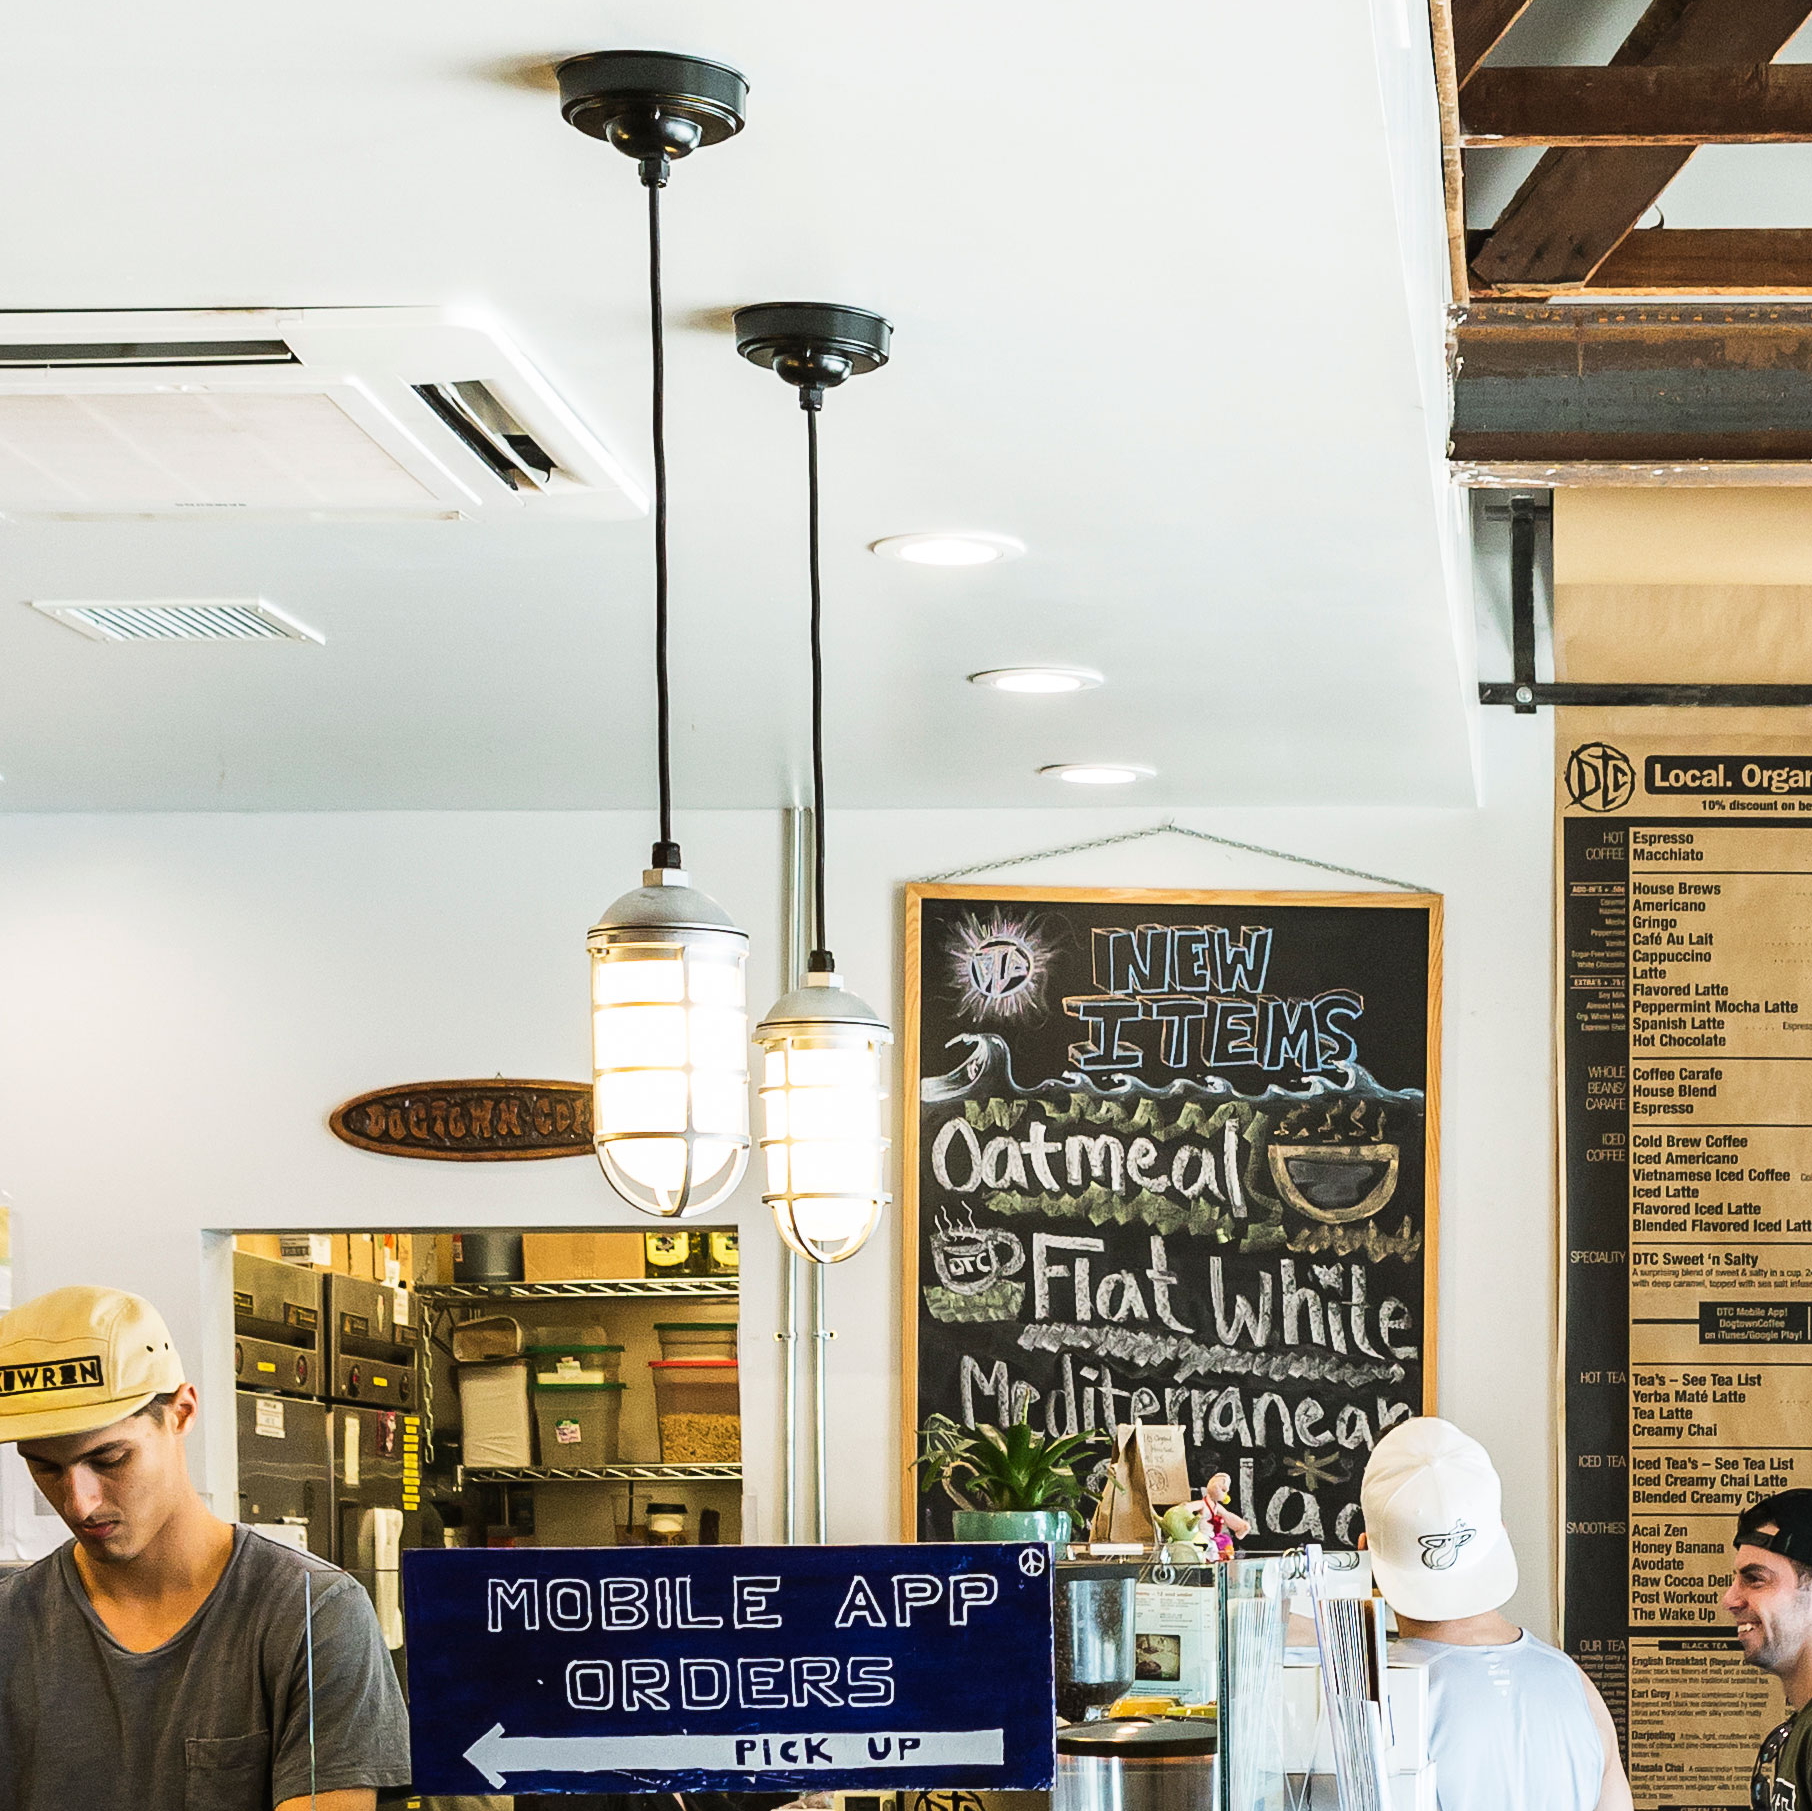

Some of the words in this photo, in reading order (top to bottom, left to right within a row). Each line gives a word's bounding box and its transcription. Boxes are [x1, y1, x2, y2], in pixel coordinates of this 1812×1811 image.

[1654, 763, 1733, 787] Local.
[1701, 799, 1726, 811] 10%
[1729, 799, 1779, 811] discount
[1780, 802, 1795, 811] on
[1603, 831, 1625, 845] HOT
[1632, 831, 1694, 847] Espresso
[1585, 847, 1625, 861] COFFEE
[1632, 847, 1704, 861] Macchiato
[1632, 881, 1675, 895] House
[1678, 881, 1721, 896] Brews
[1632, 898, 1706, 912] Americano
[1632, 915, 1677, 932] Gringo
[1632, 931, 1663, 946] Café
[1666, 932, 1685, 946] Au
[1688, 932, 1714, 946] Lait
[1091, 926, 1273, 994] NEW
[1632, 949, 1712, 966] Cappuccino
[1632, 966, 1667, 980] Latte
[1632, 983, 1691, 997] Flavored
[1694, 983, 1729, 997] Latte
[1632, 999, 1711, 1017] Peppermint
[1715, 999, 1761, 1014] Mocha
[1764, 1000, 1799, 1014] Latte
[1062, 989, 1364, 1071] ITEMS
[1632, 1016, 1687, 1033] Spanish
[1691, 1016, 1725, 1030] Latte
[1632, 1033, 1656, 1047] Hot
[1659, 1033, 1727, 1047] Chocolate
[1632, 1067, 1675, 1081] Coffee
[1679, 1067, 1723, 1081] Carafe
[1632, 1134, 1663, 1148] Cold
[1666, 1134, 1702, 1148] Brew
[1705, 1134, 1749, 1149] Coffee
[1632, 1151, 1662, 1165] Iced
[1665, 1151, 1739, 1165] Americano
[931, 1116, 1248, 1218] Oatmeal
[1632, 1168, 1712, 1182] Vietnamese
[1715, 1168, 1745, 1182] Iced
[1747, 1168, 1791, 1182] Coffee
[1632, 1201, 1691, 1215] Flavored
[1694, 1201, 1724, 1216] Iced
[1727, 1202, 1762, 1216] Latte
[1632, 1218, 1687, 1232] Blended
[1691, 1218, 1750, 1233] Flavored
[1753, 1219, 1782, 1233] Iced
[949, 1252, 992, 1276] DTC
[1569, 1251, 1626, 1265] SPECIALITY
[1632, 1252, 1659, 1266] DTC
[1662, 1252, 1705, 1266] Sweet
[1707, 1253, 1721, 1266] 'n
[1723, 1252, 1759, 1269] Salty
[1033, 1232, 1195, 1335] Flat
[1209, 1254, 1418, 1360] White
[1631, 1373, 1666, 1387] Tea's
[1681, 1373, 1707, 1387] See
[1710, 1373, 1733, 1387] Tea
[1737, 1372, 1763, 1387] List
[1632, 1389, 1671, 1404] Yerba
[1674, 1389, 1709, 1403] Maté
[1712, 1389, 1746, 1404] Latte
[1632, 1423, 1684, 1440] Creamy
[1687, 1423, 1718, 1437] Chai
[1632, 1456, 1661, 1471] Iced
[1664, 1456, 1699, 1471] Tea's
[1714, 1457, 1739, 1471] See
[1742, 1457, 1766, 1471] Tea
[1769, 1457, 1795, 1471] List
[1632, 1473, 1661, 1487] Iced
[1664, 1473, 1717, 1490] Creamy
[1720, 1473, 1750, 1487] Chai
[1753, 1473, 1788, 1488] Latte
[1632, 1490, 1687, 1504] Blended
[1690, 1490, 1743, 1507] Creamy
[1565, 1521, 1626, 1535] SMOOTHIES
[1631, 1523, 1661, 1537] Acai
[1663, 1523, 1688, 1537] Zen
[1631, 1540, 1673, 1557] Honey
[1675, 1540, 1725, 1555] Banana
[1631, 1557, 1685, 1571] Avodate
[1631, 1573, 1661, 1588] Raw
[1664, 1573, 1705, 1588] Cocoa
[488, 1575, 783, 1632] MOBILE
[835, 1574, 999, 1629] APP
[1631, 1590, 1660, 1604] Post
[1663, 1590, 1719, 1605] Workout
[1631, 1607, 1656, 1621] The
[1659, 1607, 1695, 1621] Wake
[1698, 1607, 1716, 1624] Up
[565, 1657, 895, 1711] ORDERS
[736, 1737, 833, 1765] PICK
[867, 1736, 922, 1762] UP
